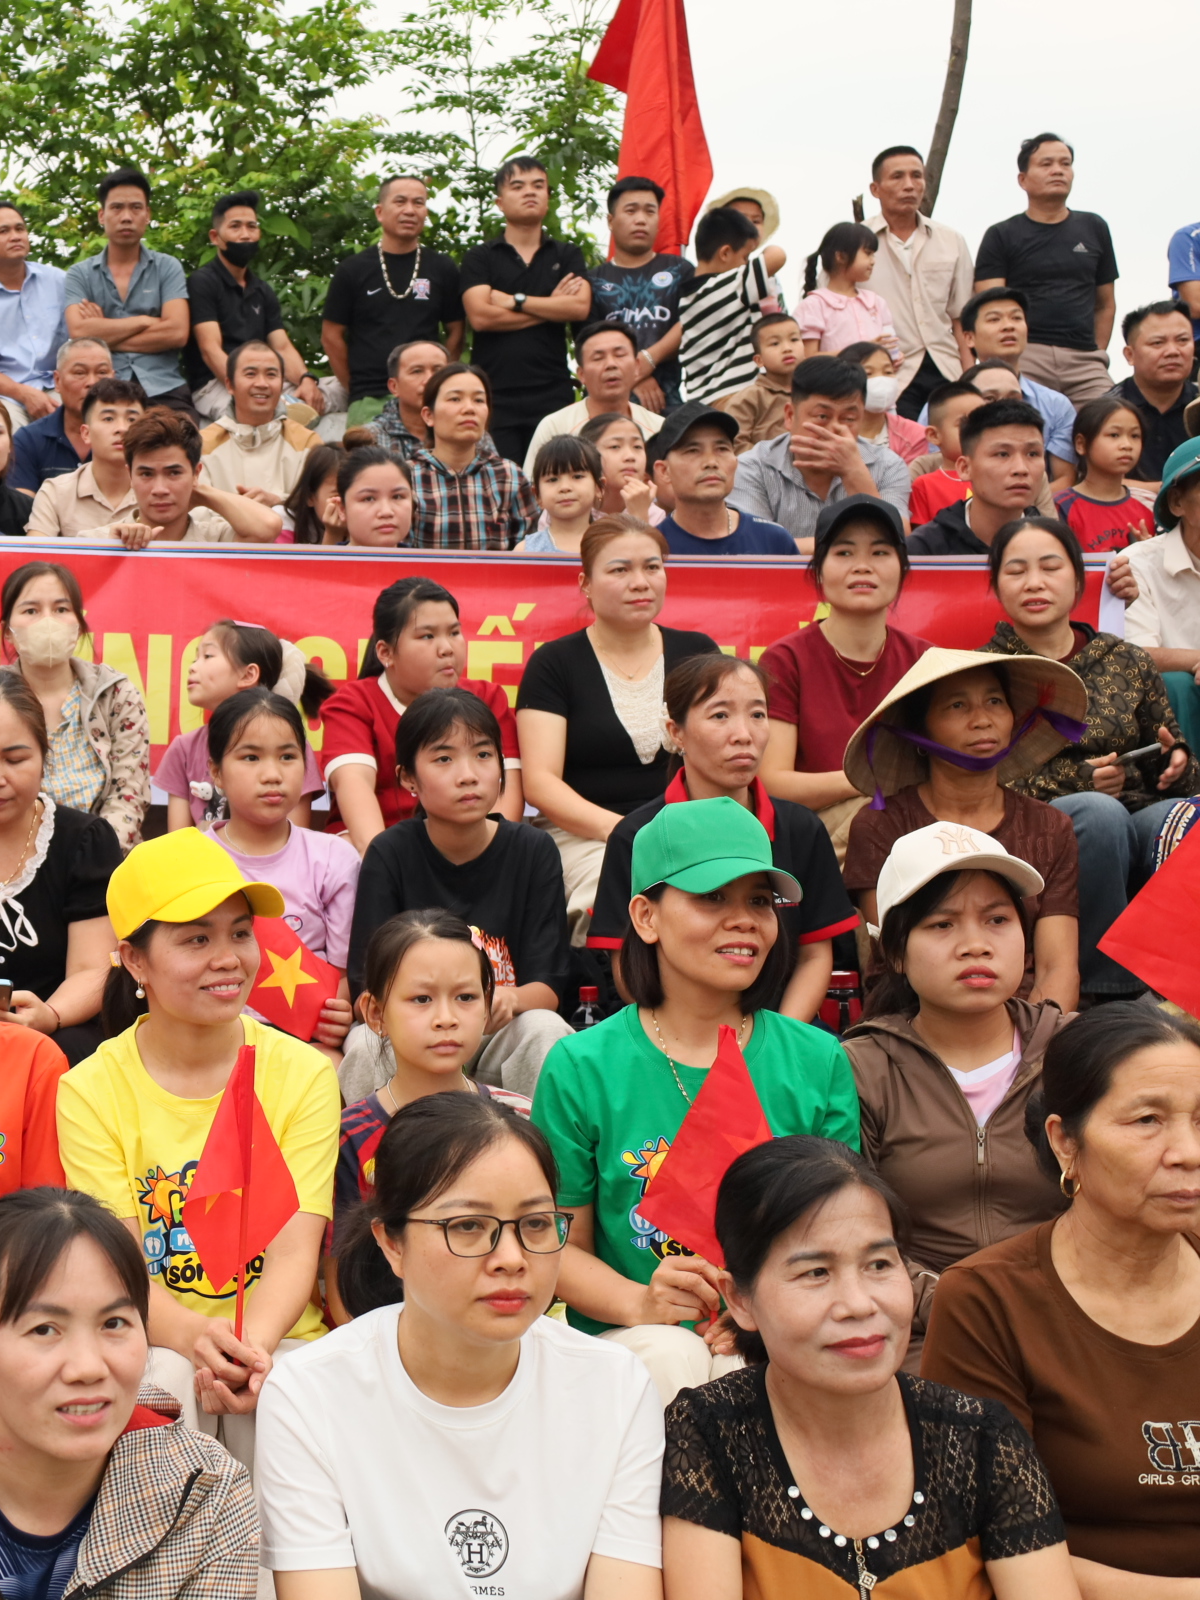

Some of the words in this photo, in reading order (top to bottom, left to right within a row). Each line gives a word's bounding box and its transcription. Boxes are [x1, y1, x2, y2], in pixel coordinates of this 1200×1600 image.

[1087, 528, 1125, 550] HAPPY
[1138, 1473, 1175, 1486] GIRLS
[465, 1543, 485, 1564] H
